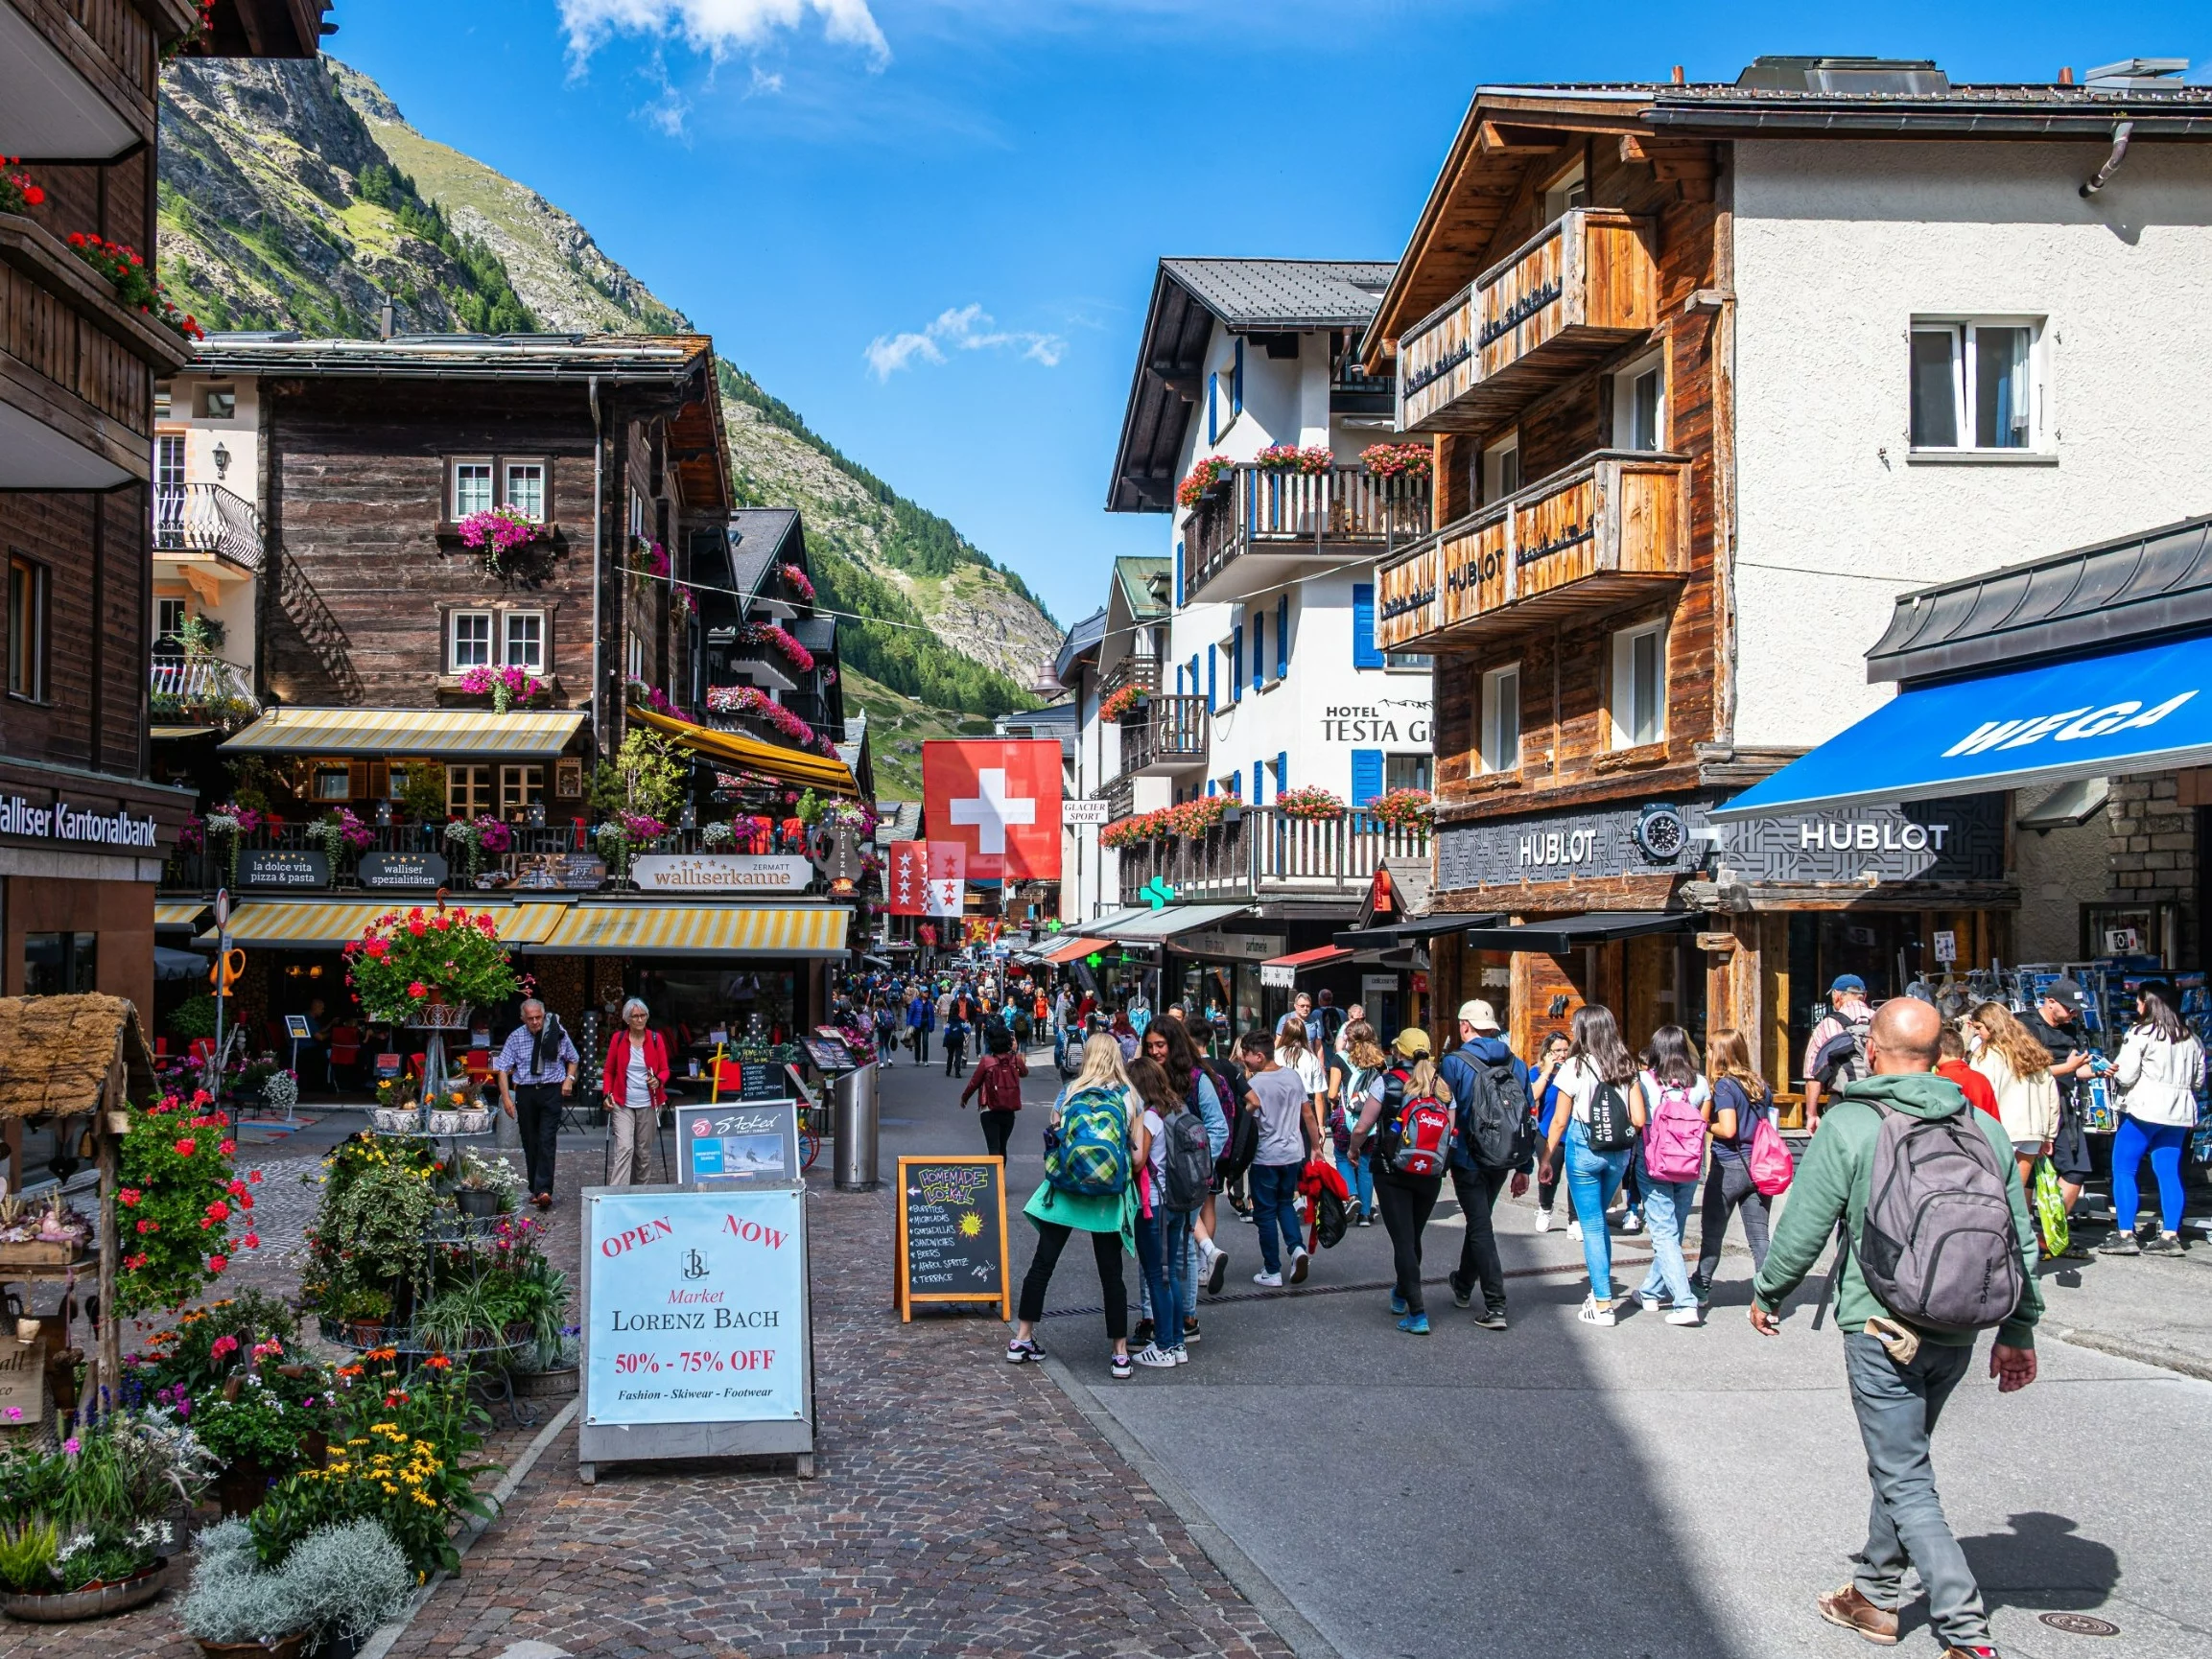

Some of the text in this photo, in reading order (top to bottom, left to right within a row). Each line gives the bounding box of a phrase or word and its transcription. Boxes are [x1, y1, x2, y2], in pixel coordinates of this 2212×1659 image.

[1447, 549, 1505, 594] HUBLOT
[1326, 706, 1379, 717] HOTEL
[1320, 719, 1399, 742] TESTA
[1940, 689, 2200, 758] WEGA
[1064, 803, 1106, 811] GLACIER
[0, 795, 157, 848] alliser Kantonalbank
[1070, 812, 1101, 821] SPORT
[1801, 823, 1949, 852] HUBLOT
[1519, 829, 1597, 866] HUBLOT
[253, 861, 312, 873] la dolce vita
[384, 863, 423, 875] walliser
[752, 863, 791, 872] ZERMATT
[250, 871, 315, 884] pizza & pasta
[371, 874, 435, 885] spezialitäten
[653, 868, 791, 886] walliserkanne
[1594, 1123, 1603, 1141] ALL
[920, 1167, 986, 1188] HOMEMADE
[912, 1204, 945, 1214] BURRITOS
[601, 1213, 789, 1258] OPEN NOW
[913, 1225, 956, 1235] QUESADILLAS
[914, 1237, 955, 1248] SANDWICHES
[916, 1249, 941, 1259] BEERS
[918, 1257, 969, 1272] APEROL SPRITZ
[918, 1273, 953, 1284] TERRACE
[1980, 1256, 1993, 1305] DAKINE
[668, 1288, 725, 1304] Market
[611, 1307, 781, 1332] LORENZ BACH
[615, 1351, 660, 1374] 50%
[679, 1350, 724, 1372] 75%
[730, 1349, 776, 1371] OFF
[618, 1390, 662, 1401] Fashion
[671, 1388, 714, 1400] Skiwear
[723, 1387, 773, 1398] Footwear
